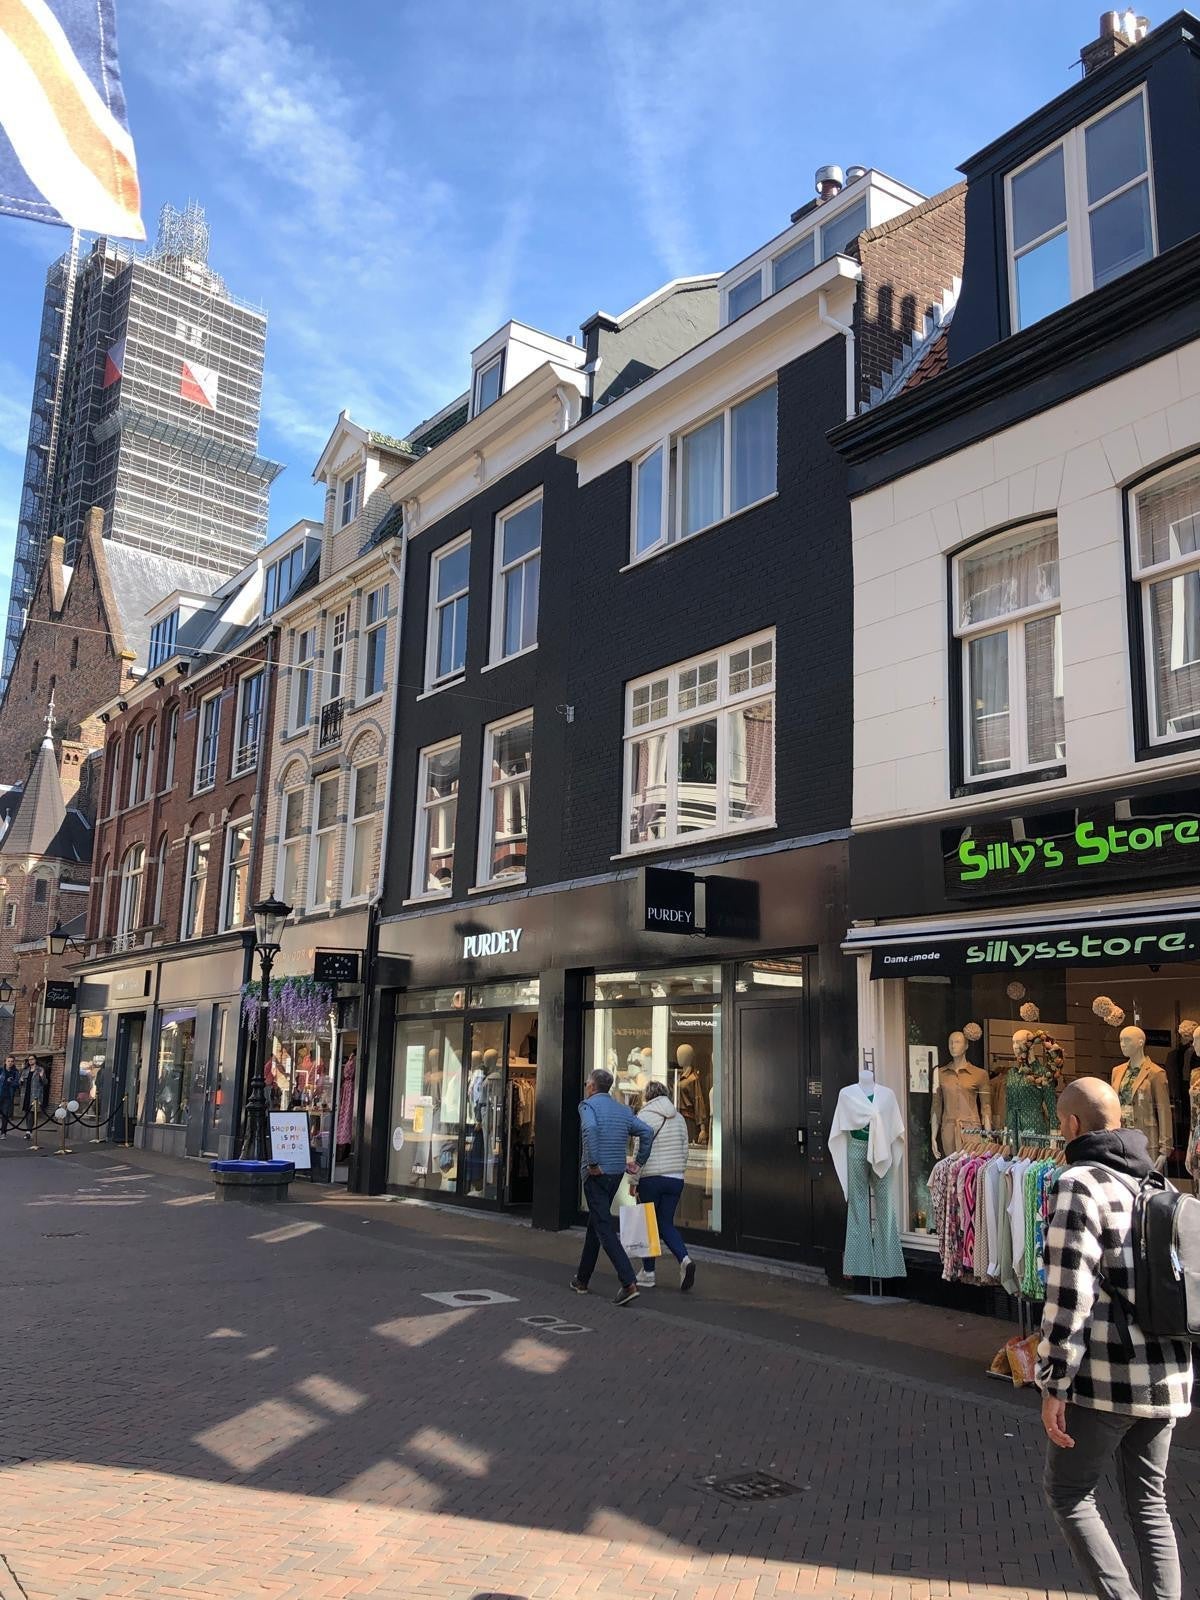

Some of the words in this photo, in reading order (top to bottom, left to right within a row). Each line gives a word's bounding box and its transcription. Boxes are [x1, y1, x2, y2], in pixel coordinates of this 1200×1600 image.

[958, 837, 1064, 881] Silly's
[1075, 820, 1200, 866] Store
[647, 907, 692, 923] PURDEY
[463, 927, 522, 959] PURDEY
